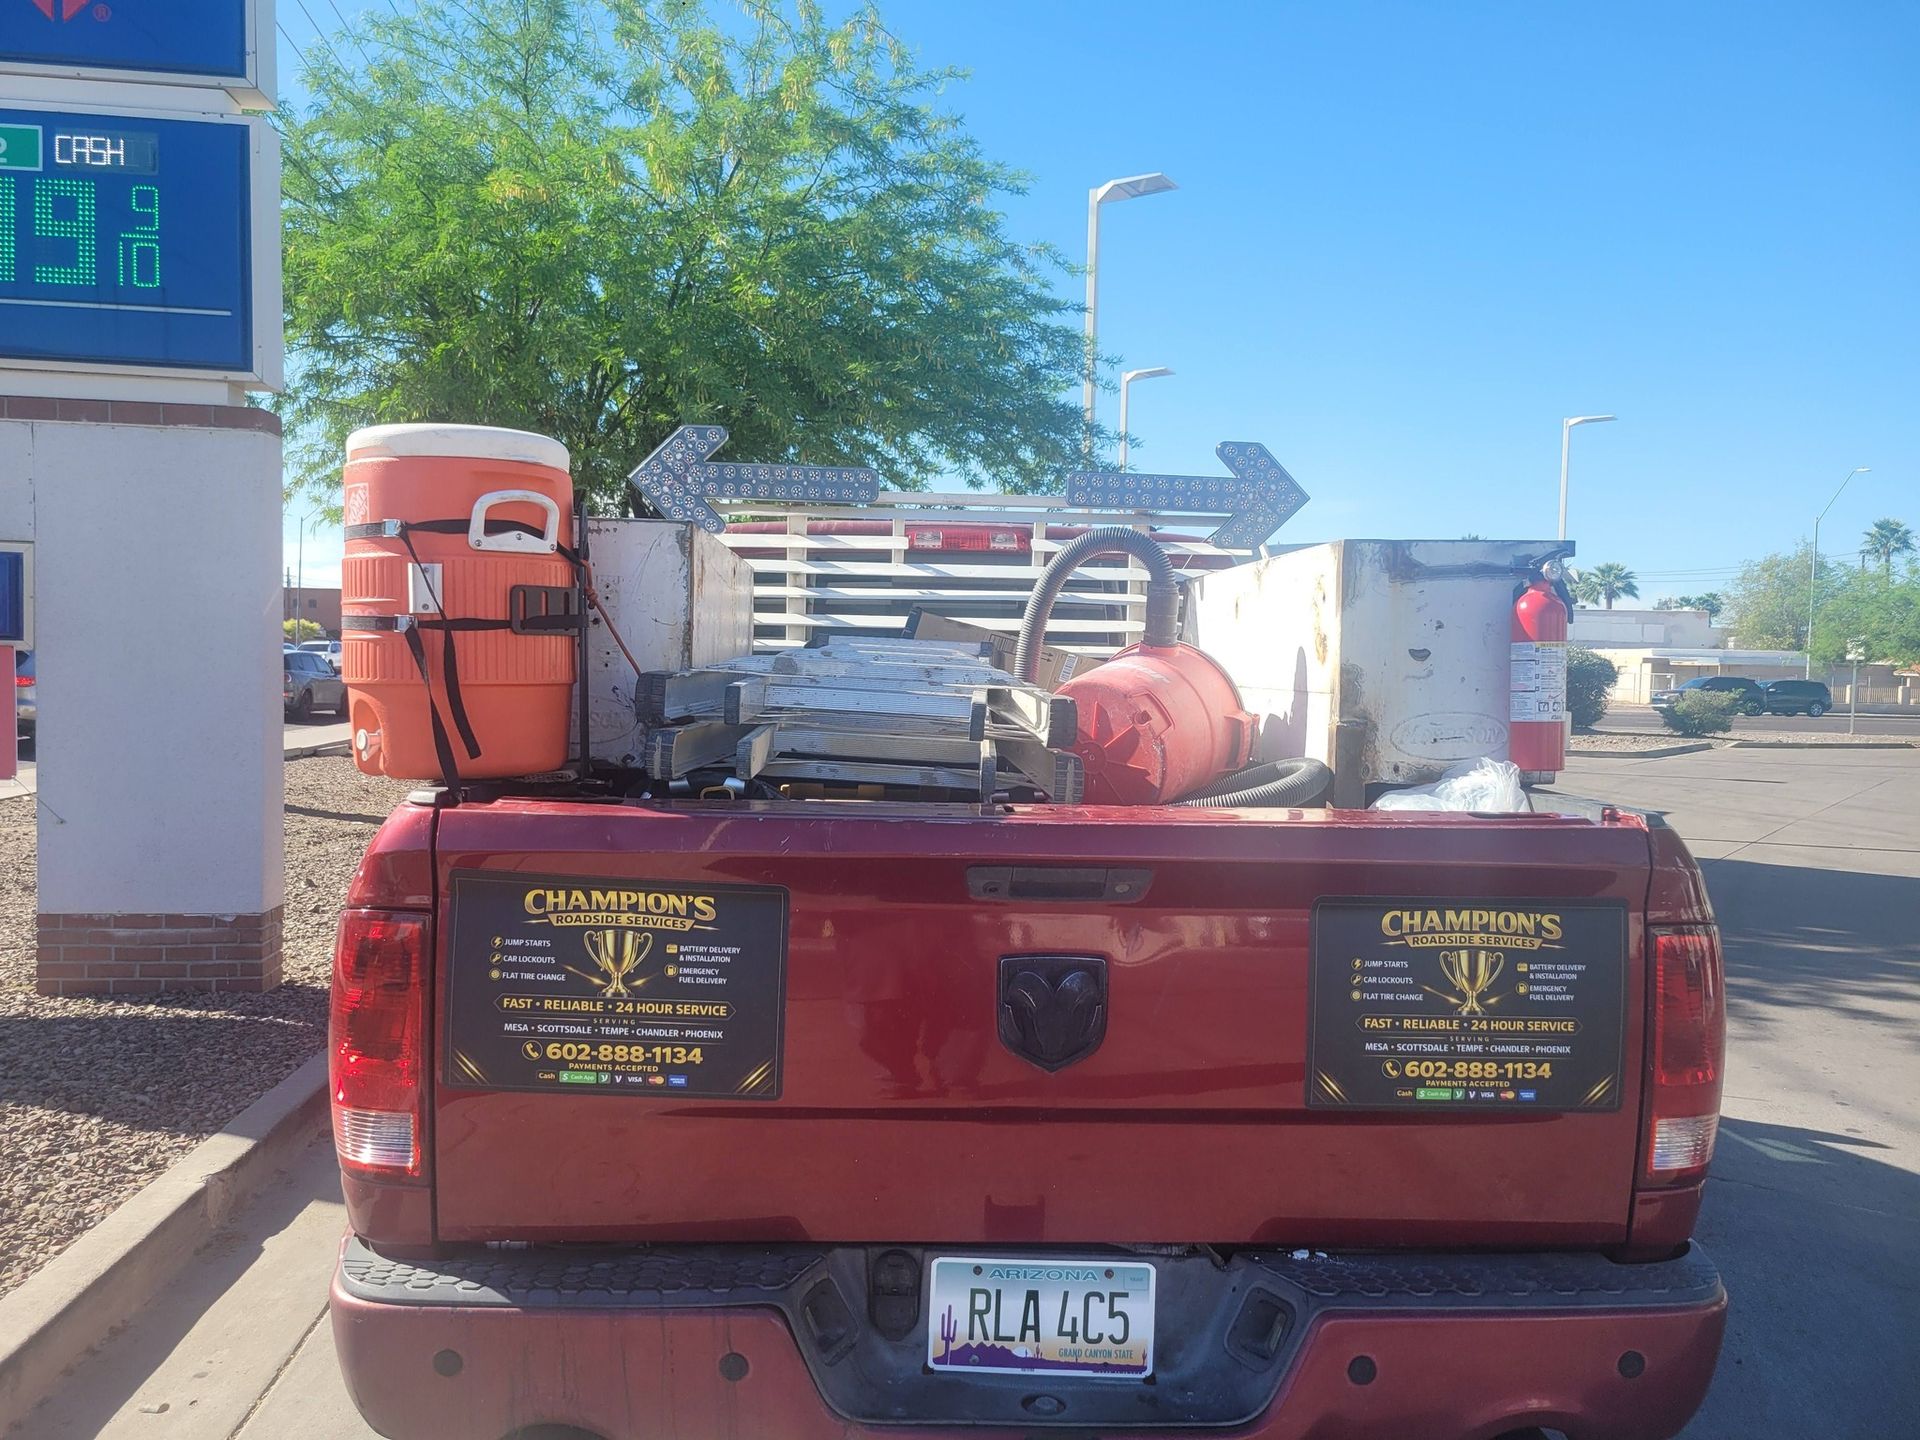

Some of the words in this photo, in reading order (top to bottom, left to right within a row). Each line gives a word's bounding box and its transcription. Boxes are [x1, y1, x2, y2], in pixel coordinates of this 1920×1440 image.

[55, 135, 125, 166] CASH
[131, 185, 159, 230] 9
[118, 240, 160, 288] 10
[524, 888, 717, 922] CHAMPION'S
[556, 914, 622, 925] ROADSIDE
[627, 915, 687, 930] SERVICES
[1381, 910, 1562, 940] CHAMPION'S
[504, 938, 524, 946] JUMP
[525, 939, 551, 948] STARTS
[1412, 936, 1474, 945] ROADSIDE
[1479, 936, 1535, 948] SERVICES
[680, 945, 708, 953] BATTERY
[709, 946, 741, 955] DELIVERY
[503, 954, 518, 963] CAR
[518, 955, 556, 964] LOCKOUTS
[679, 954, 685, 962] &
[685, 954, 731, 963] INSTALLATION
[1364, 961, 1383, 969] JUMP
[1384, 961, 1409, 969] STARTS
[1529, 963, 1556, 971] BATTERY
[1556, 964, 1586, 972] DELIVERY
[502, 971, 519, 980] FLAT
[520, 972, 536, 981] TIRE
[536, 973, 566, 982] CHANGE
[679, 967, 719, 976] EMERGENCY
[1535, 973, 1577, 981] INSTALLATION
[679, 976, 695, 984] FUEL
[696, 977, 727, 985] DELIVERY
[1363, 976, 1377, 984] CAR
[1378, 977, 1413, 985] LOCKOUTS
[1529, 984, 1567, 992] EMERGENCY
[1380, 993, 1395, 1001] TIRE
[503, 998, 533, 1010] FAST
[544, 999, 604, 1013] RELIABLE
[615, 1002, 634, 1014] 24
[637, 1003, 673, 1015] HOUR
[676, 1004, 727, 1017] SERVICE
[593, 1018, 636, 1026] SERVING
[1364, 1018, 1392, 1029] FAST
[1403, 1019, 1460, 1030] RELIABLE
[1470, 1020, 1488, 1031] 24
[1490, 1020, 1525, 1031] HOUR
[1527, 1021, 1575, 1032] SERVICE
[504, 1023, 529, 1033] MESA
[537, 1025, 592, 1035] SCOTTSDALE
[600, 1027, 629, 1037] TEMPE
[636, 1028, 679, 1038] CHANDLER
[685, 1030, 723, 1040] PHOENIX
[546, 1042, 704, 1065] 602-888-1134
[1365, 1043, 1389, 1051] MESA
[1396, 1043, 1449, 1052] SCOTTSDALE
[1456, 1045, 1484, 1053] TEMPE
[1490, 1045, 1530, 1054] CHANDLER
[1535, 1046, 1571, 1054] PHOENIX
[568, 1063, 612, 1072] PAYMENTS
[615, 1065, 659, 1073] ACCEPTED
[1404, 1061, 1552, 1079] 602-888-1134
[538, 1072, 556, 1080] Cash
[1397, 1089, 1413, 1097] Cash
[989, 1269, 1098, 1281] ARIZONA
[968, 1288, 1041, 1343] RLA
[1057, 1290, 1130, 1345] 4C5
[1058, 1348, 1083, 1358] GRAND
[1084, 1349, 1112, 1358] CANYON
[1114, 1350, 1134, 1360] STATE
